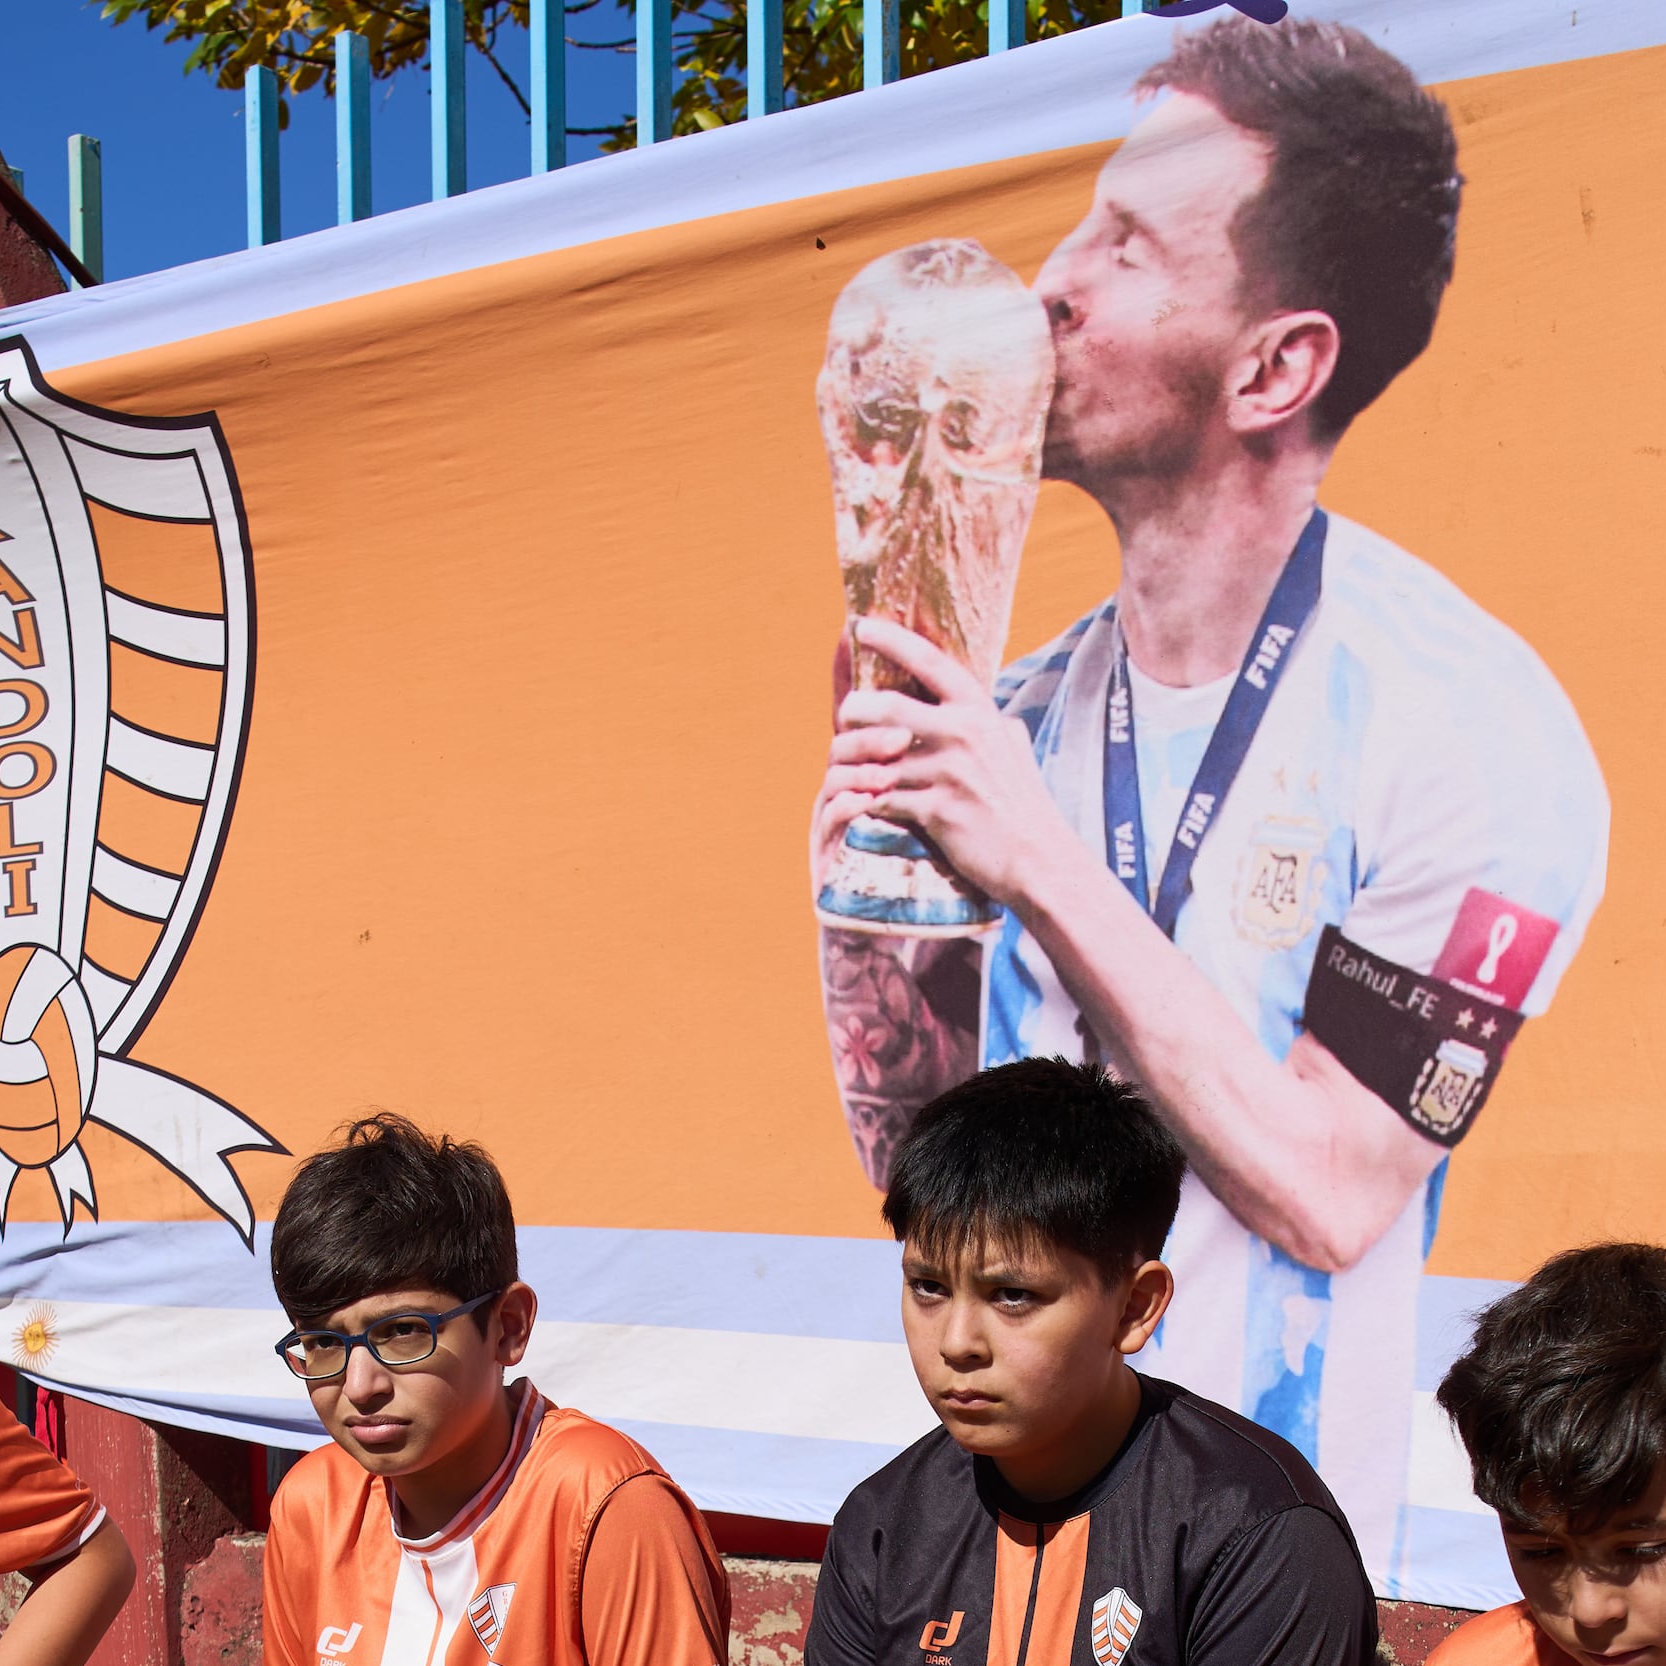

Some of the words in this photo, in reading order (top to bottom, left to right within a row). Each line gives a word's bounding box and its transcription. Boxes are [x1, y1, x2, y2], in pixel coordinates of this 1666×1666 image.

[1243, 623, 1295, 691] FIFA
[1113, 821, 1138, 879] FIFA
[1176, 792, 1216, 850] FIFA
[925, 1653, 953, 1666] DARK
